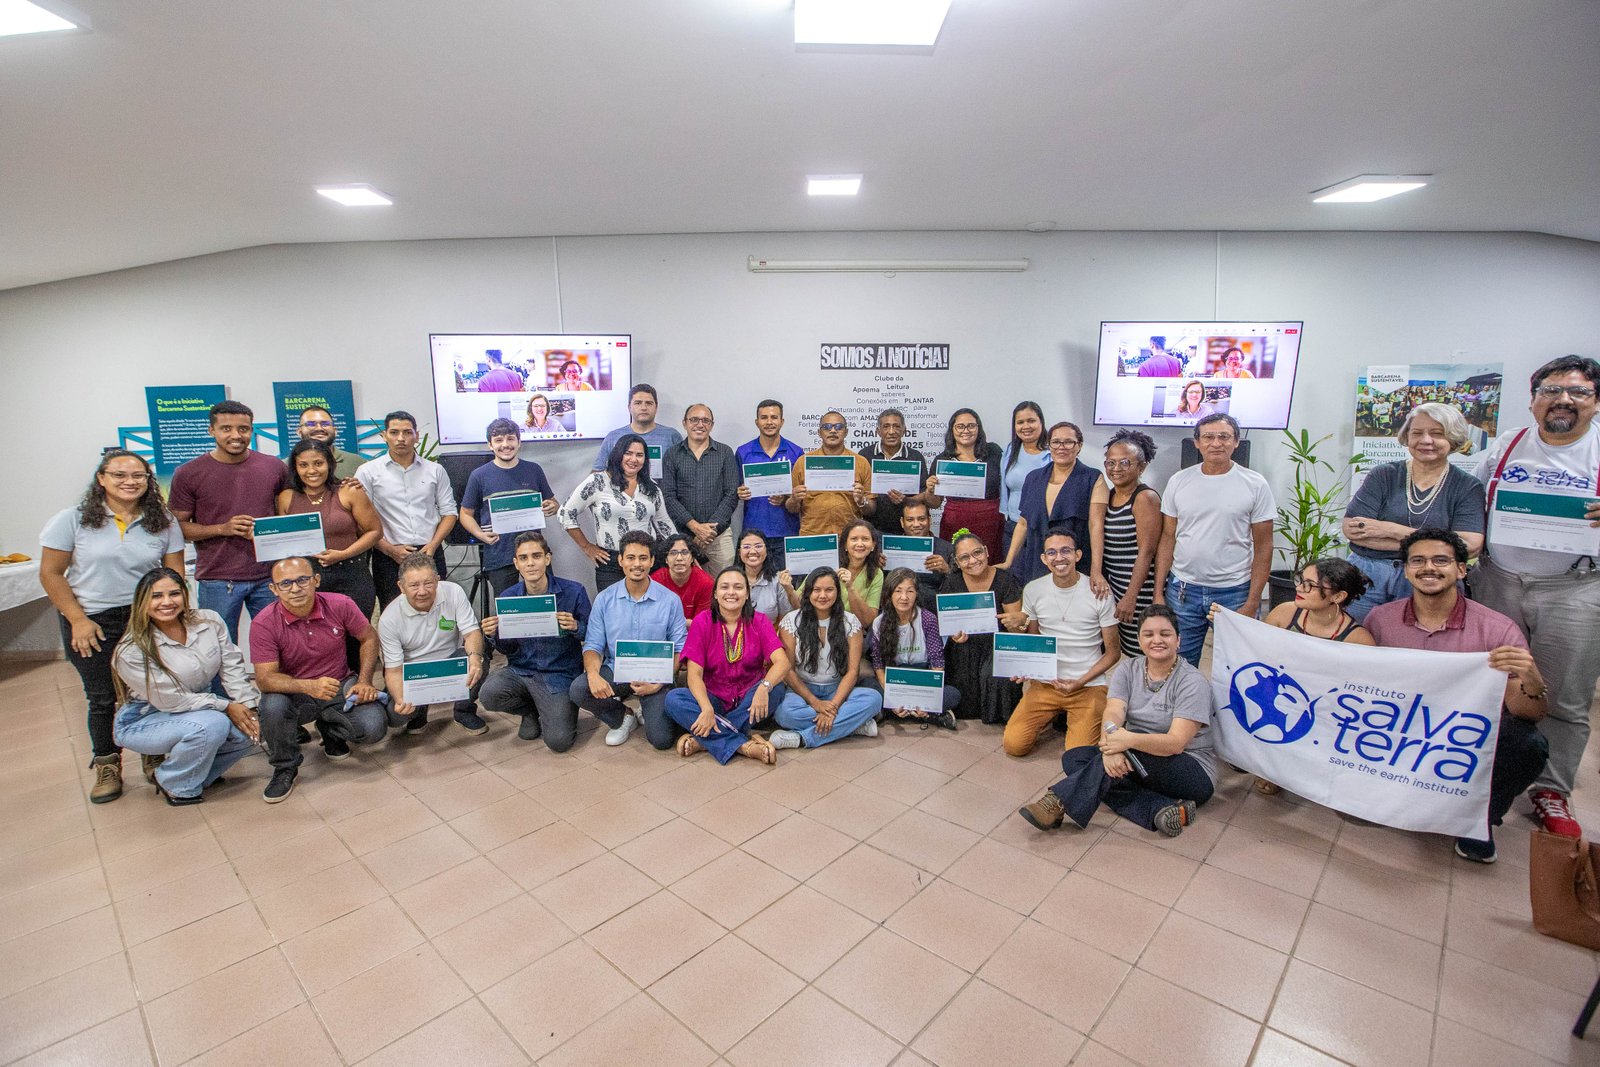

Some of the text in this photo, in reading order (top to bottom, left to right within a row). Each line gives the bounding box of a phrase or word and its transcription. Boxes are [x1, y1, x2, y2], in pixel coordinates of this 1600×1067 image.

[821, 344, 948, 369] SOMOS A NOTÍCIA!
[1344, 681, 1406, 700] instituto
[1331, 693, 1492, 748] salva
[1334, 716, 1479, 783] terra
[1328, 756, 1469, 798] save the earth institute
